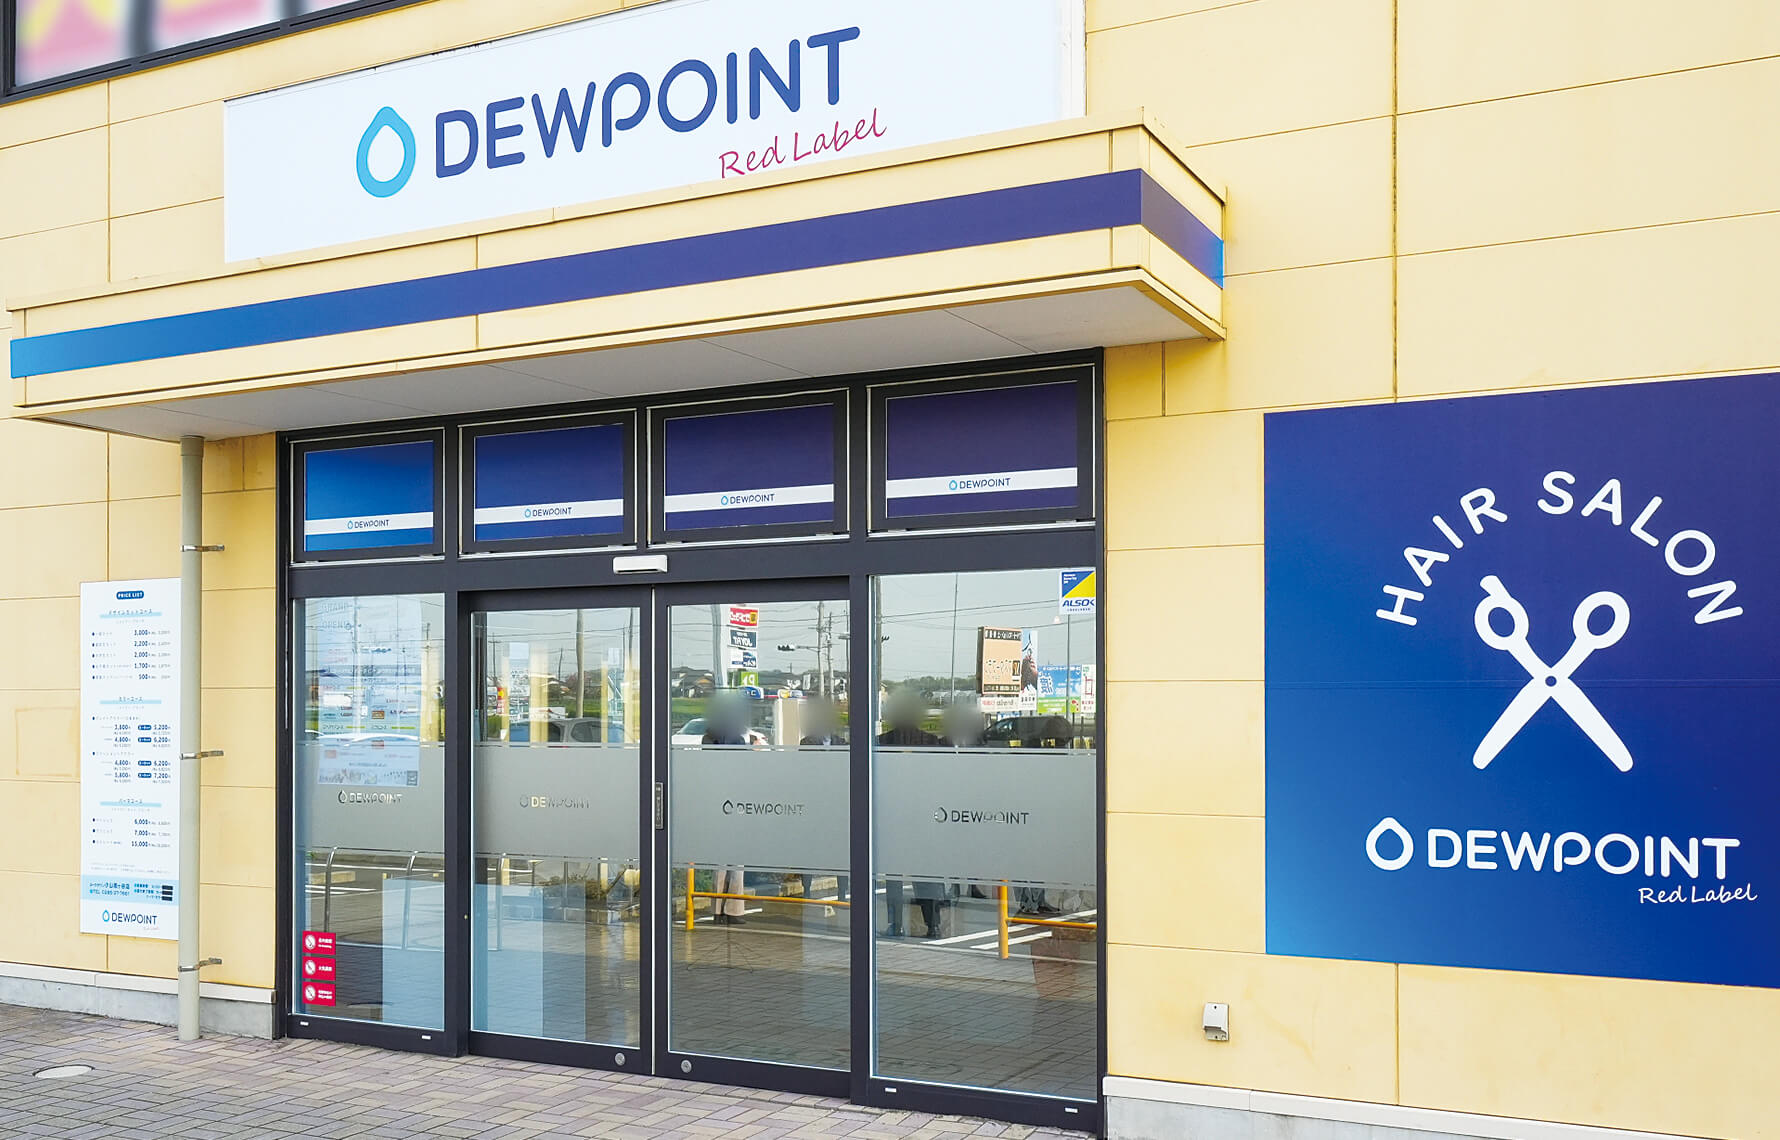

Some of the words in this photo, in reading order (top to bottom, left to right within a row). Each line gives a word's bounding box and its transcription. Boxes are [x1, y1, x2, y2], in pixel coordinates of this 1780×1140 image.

[436, 26, 859, 178] DEWPOINT
[719, 136, 786, 179] Red
[793, 109, 886, 161] Label
[959, 477, 1012, 493] DEWPOINT
[730, 493, 775, 506] DEWPOINT
[532, 506, 572, 518] DEWPOINT
[354, 519, 389, 530] DEWPOINT
[1376, 488, 1507, 625] HAIR
[1537, 471, 1743, 626] SALON
[1062, 599, 1095, 607] ALSOK
[349, 792, 403, 804] DEWPOINT
[736, 803, 806, 817] DEWPOINT
[951, 810, 1029, 825] DEWPOINT
[1427, 829, 1741, 879] DEWPOINT
[1638, 887, 1687, 904] Red
[1691, 883, 1757, 904] Label
[112, 912, 157, 925] DEWPOINT
